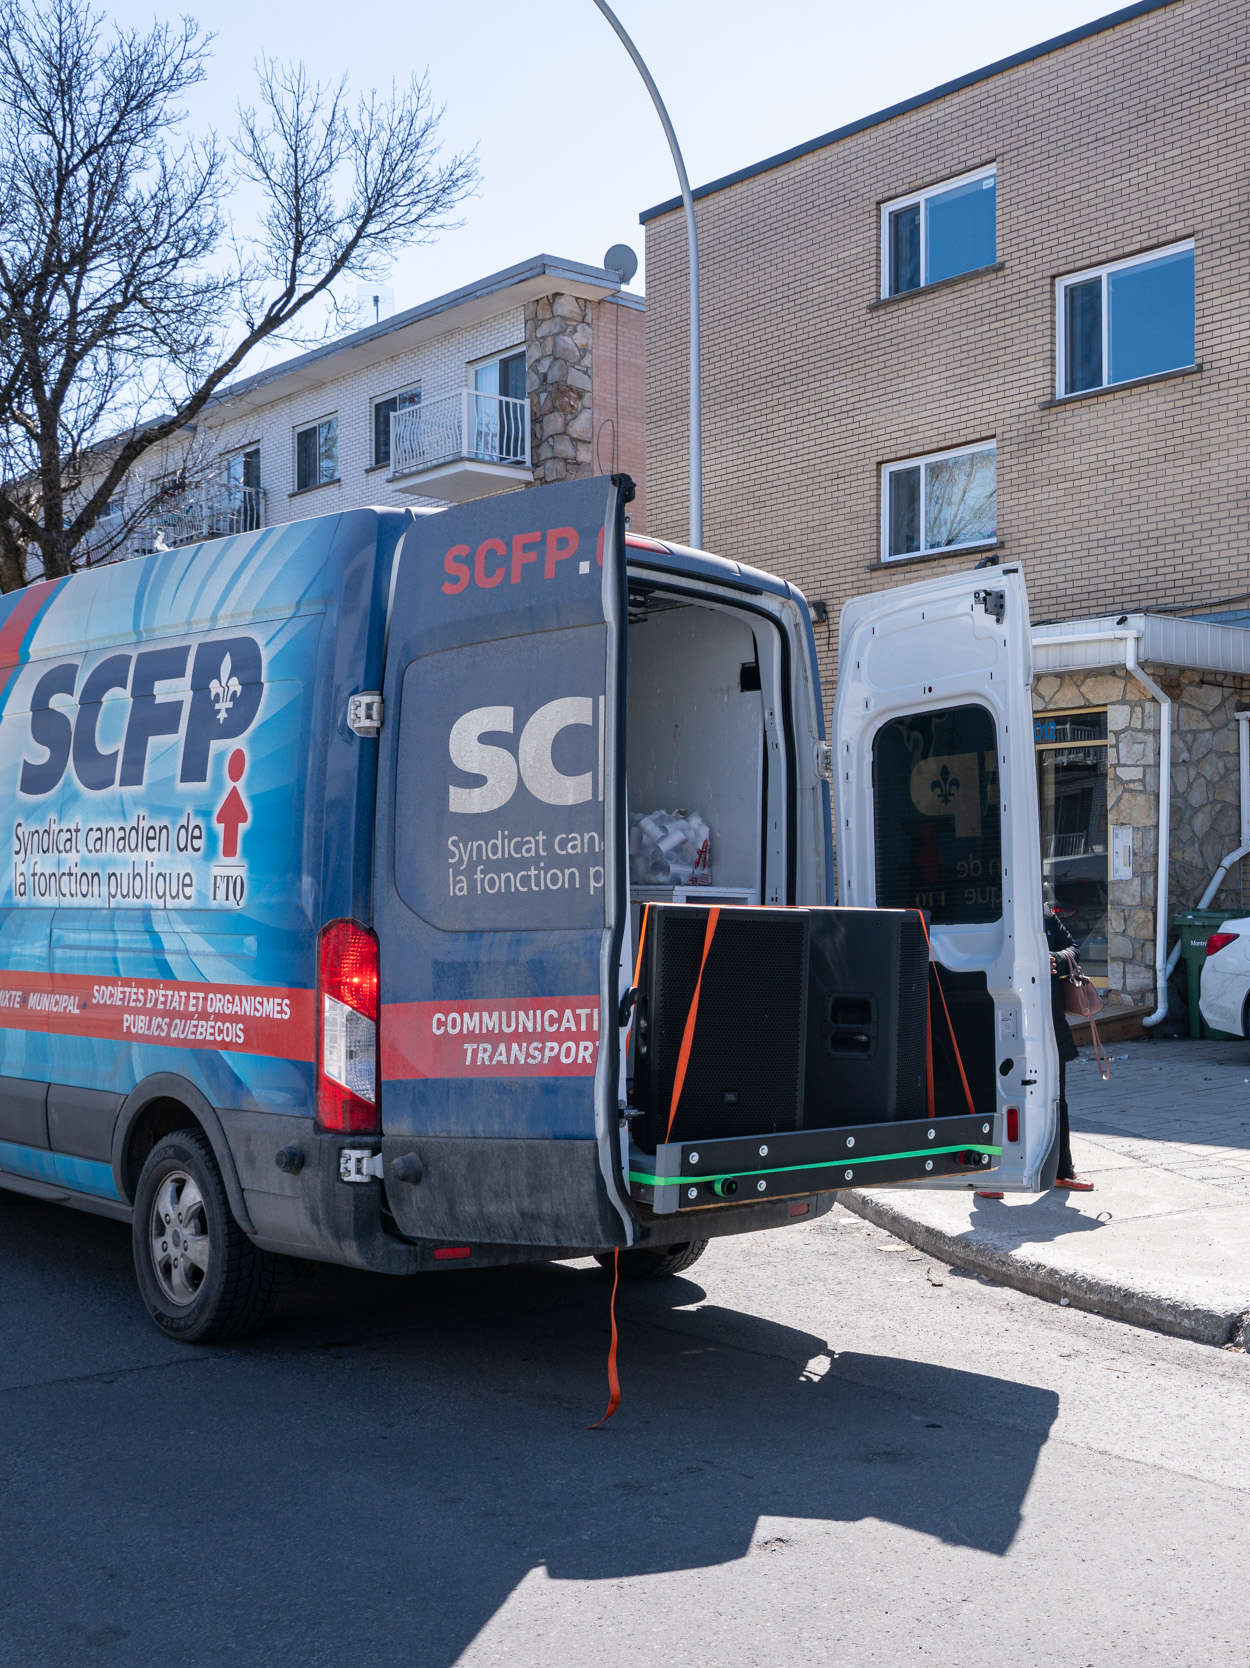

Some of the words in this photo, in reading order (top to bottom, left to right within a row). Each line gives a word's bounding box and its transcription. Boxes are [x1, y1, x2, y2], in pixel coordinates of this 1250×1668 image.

[441, 525, 605, 595] SCFP.
[19, 636, 264, 796] SCFP
[449, 695, 605, 814] SC
[14, 818, 81, 864] Syndicat
[85, 814, 170, 854] canadien
[177, 812, 203, 853] de
[448, 830, 547, 870] Syndicat
[554, 831, 604, 855] can
[14, 861, 27, 898] la
[31, 861, 101, 899] fonction
[108, 861, 194, 909] publique
[212, 874, 246, 907] FTQ
[449, 868, 468, 897] la
[474, 862, 580, 895] fonction
[28, 992, 80, 1014] MUNICIPAL
[189, 992, 204, 1013] ET
[207, 993, 291, 1020] ORGANISMES
[122, 1014, 170, 1037] PUBLICS
[170, 1014, 245, 1044] QUÉBÉCOIS
[432, 1008, 599, 1036] COMMUNICATI
